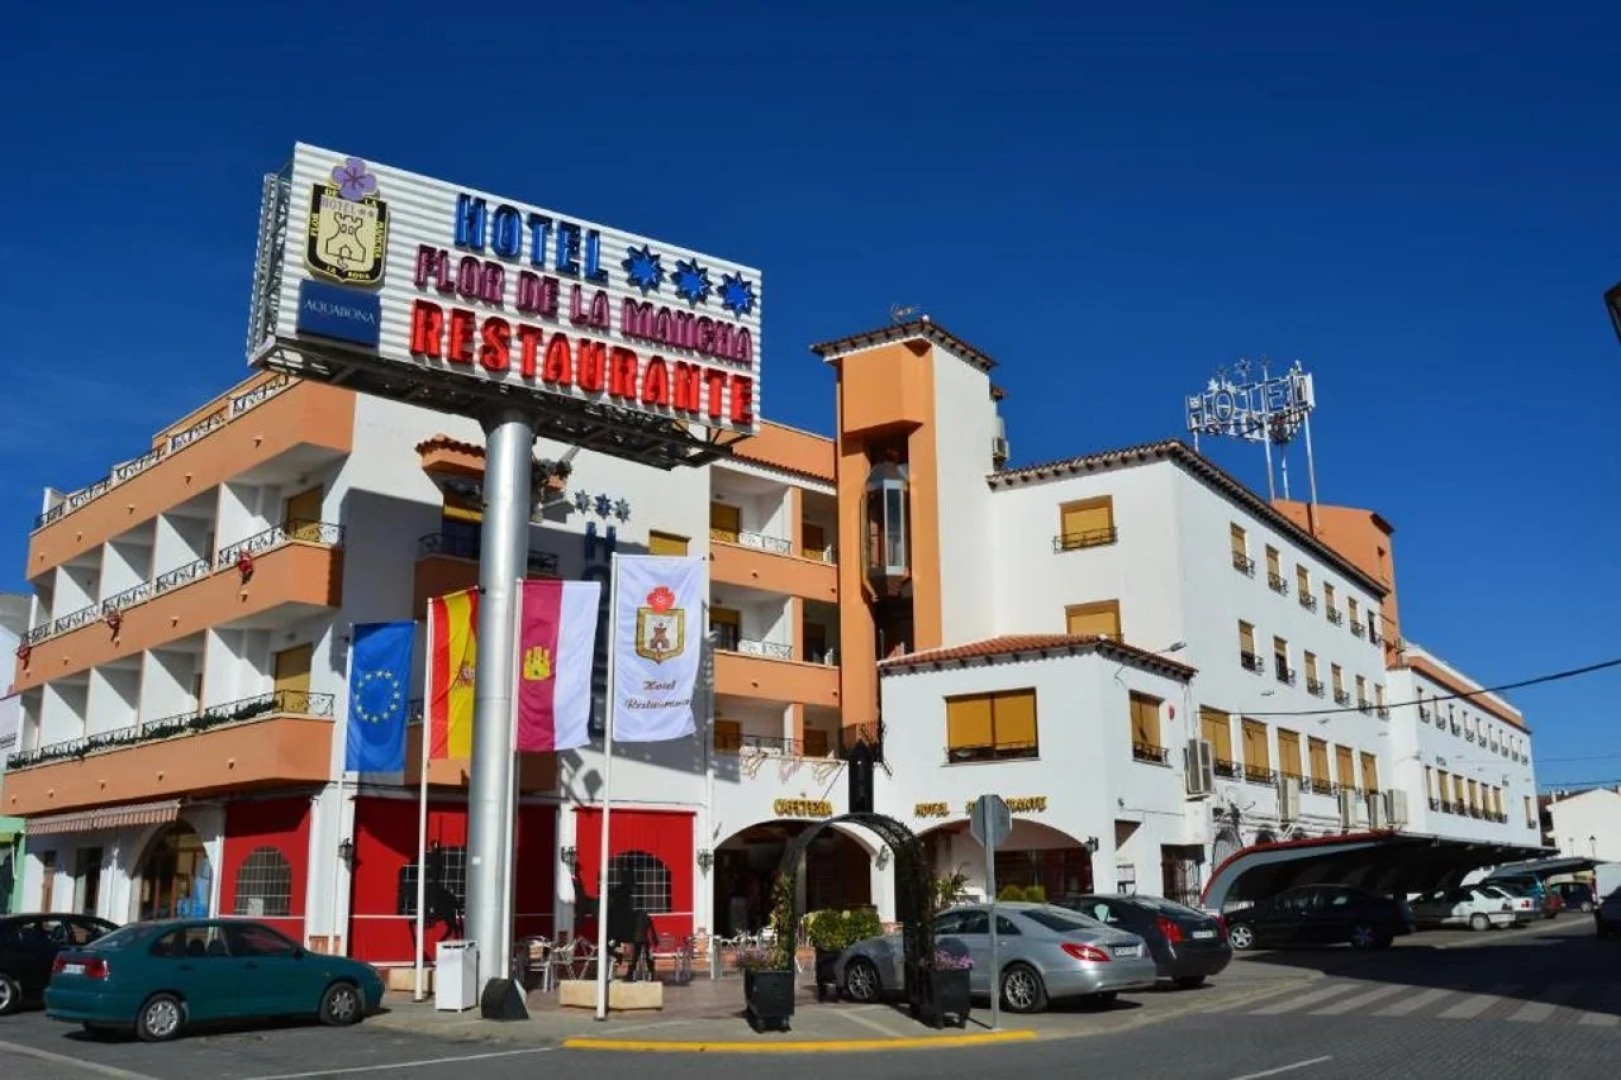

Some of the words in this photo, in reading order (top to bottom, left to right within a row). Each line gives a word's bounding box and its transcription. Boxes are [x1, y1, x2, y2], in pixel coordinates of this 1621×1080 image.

[454, 192, 609, 283] HOTEL
[304, 298, 376, 325] AQUABONA
[413, 243, 505, 304] FLOR
[516, 269, 560, 319] DE
[569, 283, 610, 330] LA
[620, 296, 753, 363] MANCHA
[408, 298, 753, 425] RESTAURANTE
[1185, 373, 1312, 431] HOTEL
[914, 802, 950, 818] HOTEL
